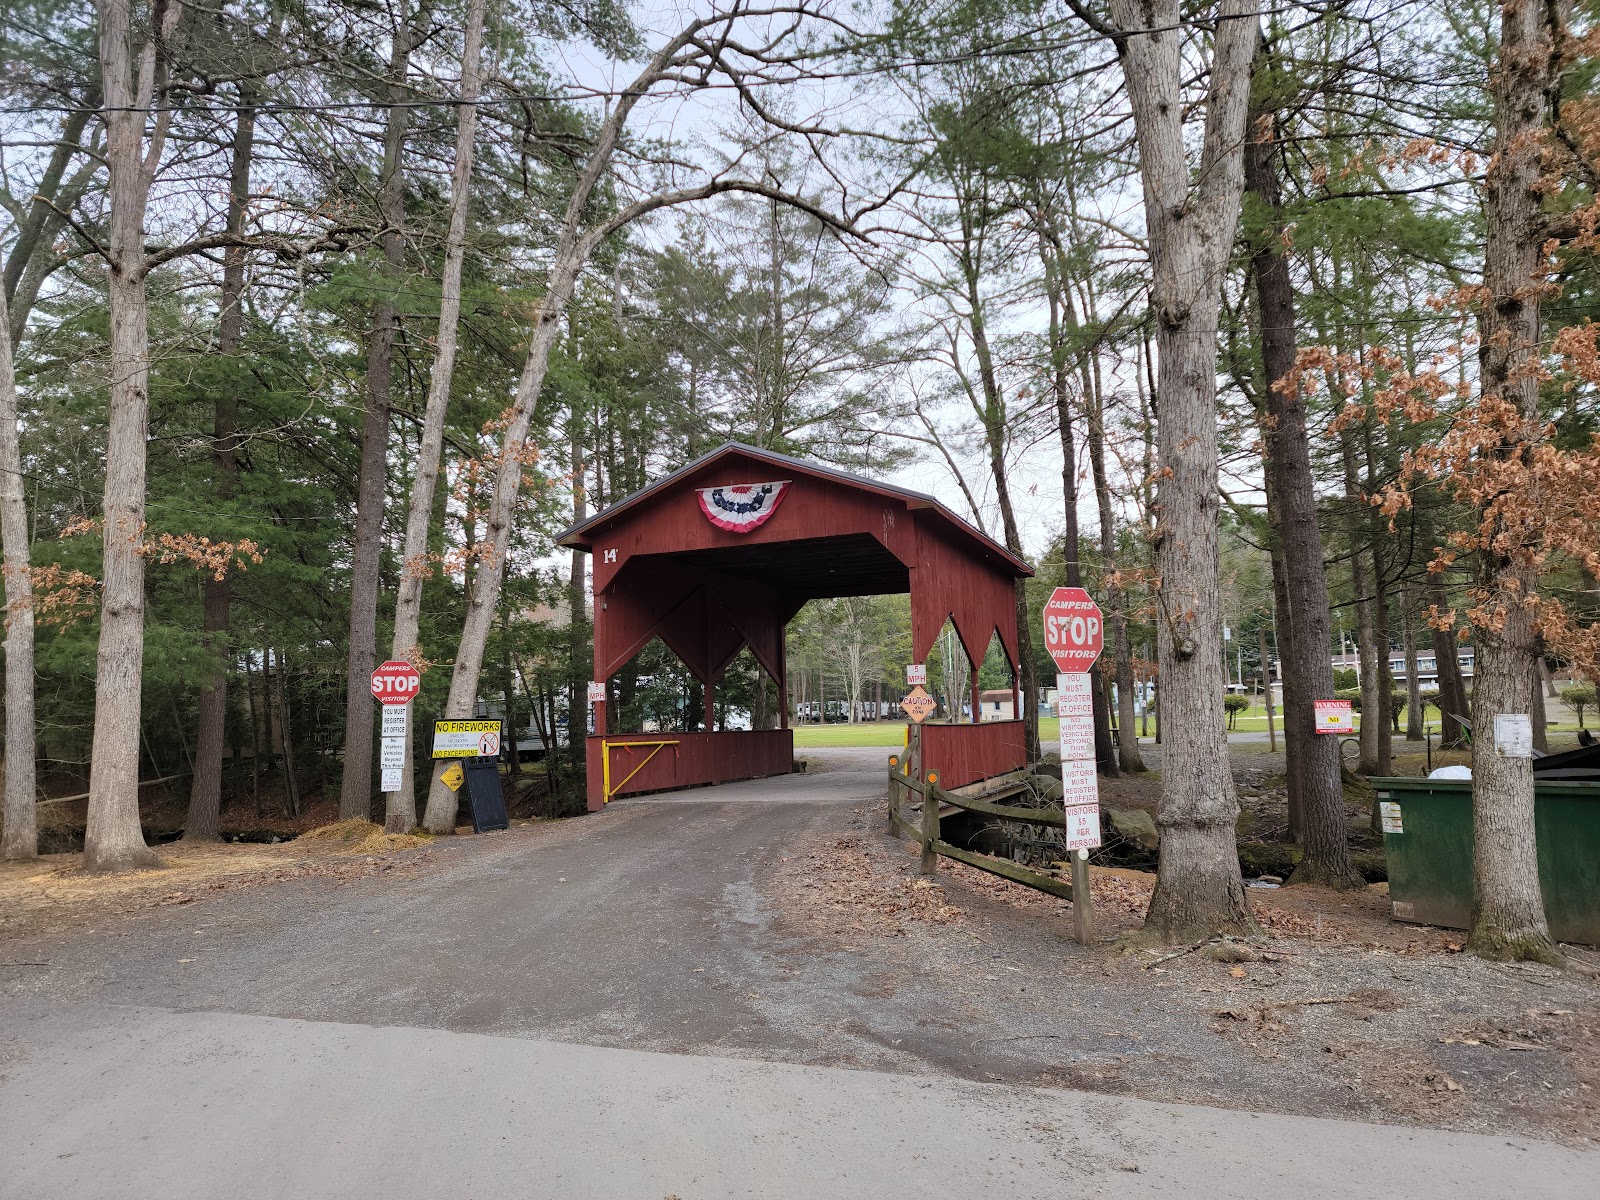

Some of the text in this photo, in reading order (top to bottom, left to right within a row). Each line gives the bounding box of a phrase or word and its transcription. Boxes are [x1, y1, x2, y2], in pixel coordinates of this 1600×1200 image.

[603, 548, 619, 563] 14'
[1049, 600, 1094, 610] CAMPERS
[1047, 615, 1099, 645] STOP
[1052, 649, 1097, 659] VISITORS
[908, 675, 926, 683] MPH
[1067, 674, 1081, 682] YOU
[372, 675, 419, 692] STOP
[1065, 684, 1083, 692] MUST
[904, 697, 932, 705] CAUTION
[1060, 694, 1091, 703] REGISTER
[1060, 704, 1092, 713] AT OFFICE
[436, 721, 500, 732] NO FIREWORKS
[1061, 723, 1093, 731] VISITORS
[1061, 730, 1094, 738] VEHICLES
[1063, 737, 1092, 745] BEYOND
[443, 749, 478, 757] EXCEPTIONS
[1065, 769, 1094, 777] VISITORS
[1071, 778, 1089, 786] MUST
[1065, 786, 1096, 795] REGISTER
[1074, 794, 1097, 803] OFFICE
[1066, 805, 1099, 817] VISITORS
[1076, 828, 1091, 837] PER
[1069, 838, 1099, 849] PERSON
